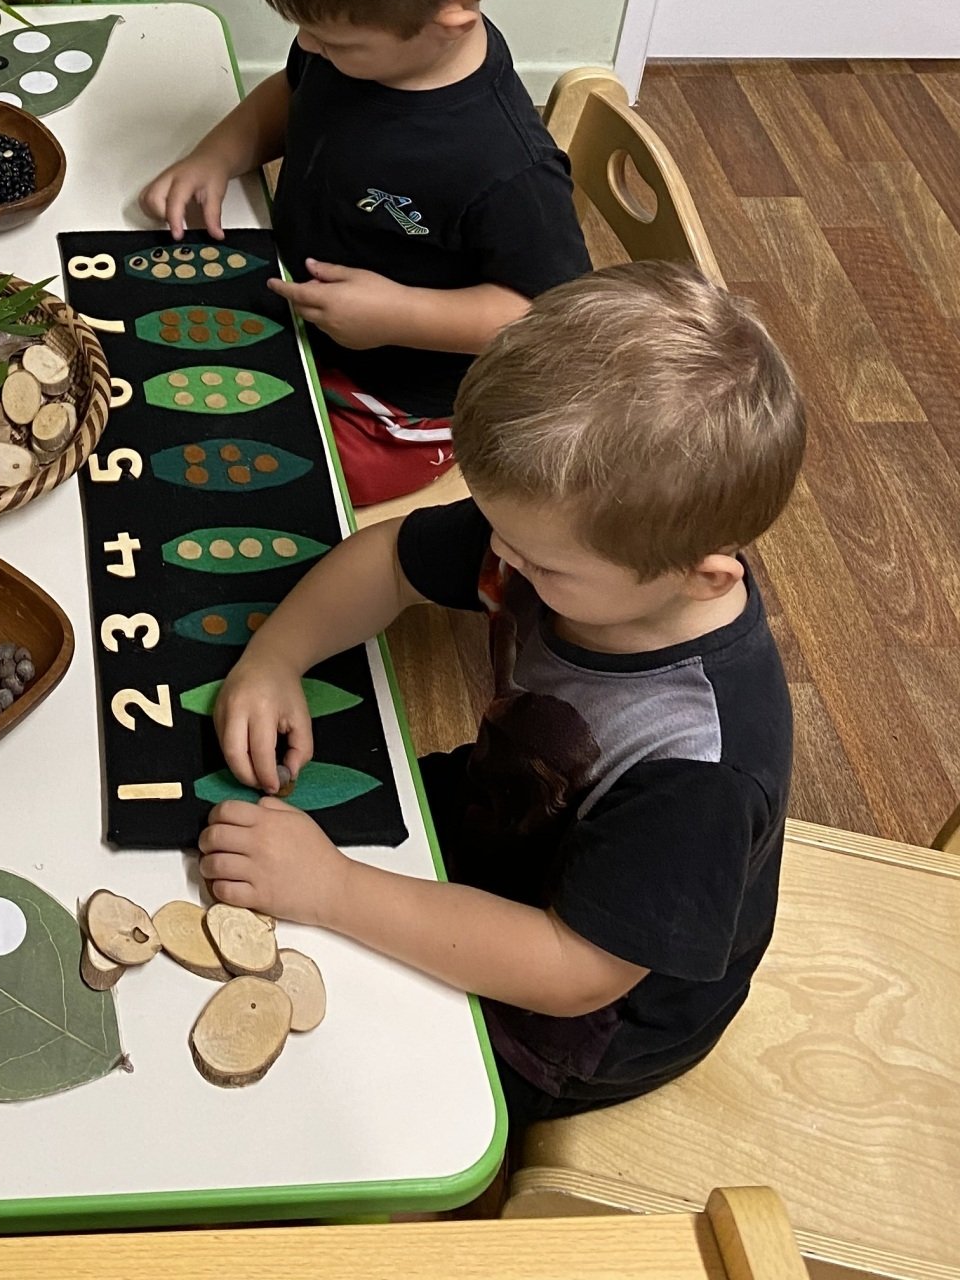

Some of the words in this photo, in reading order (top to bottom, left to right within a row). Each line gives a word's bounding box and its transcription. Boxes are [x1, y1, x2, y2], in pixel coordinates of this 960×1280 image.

[67, 253, 117, 279] 8
[89, 447, 143, 483] 5
[104, 532, 141, 578] 4
[101, 612, 162, 653] 3
[111, 684, 173, 731] 2
